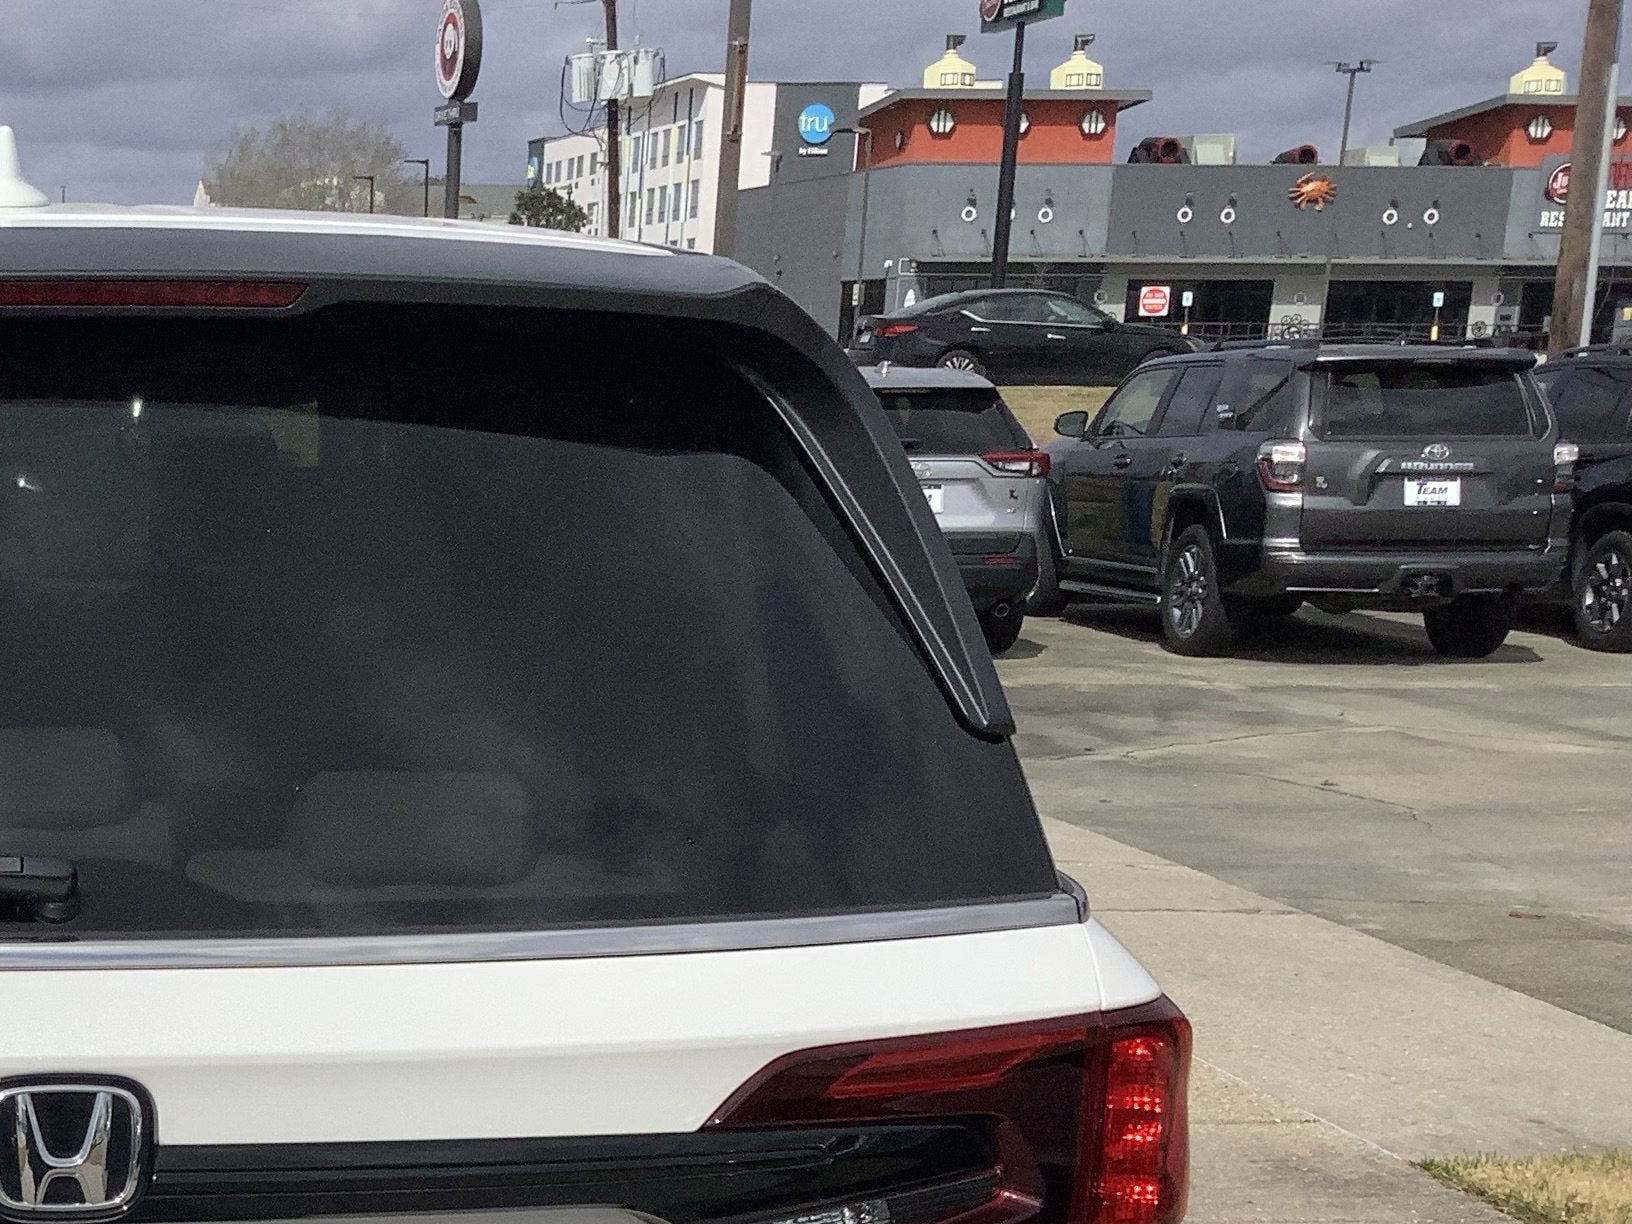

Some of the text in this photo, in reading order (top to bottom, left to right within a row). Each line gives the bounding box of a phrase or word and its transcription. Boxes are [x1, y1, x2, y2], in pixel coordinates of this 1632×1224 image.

[800, 113, 828, 132] tru
[1539, 211, 1630, 228] RESANT
[1416, 480, 1449, 495] TEAM
